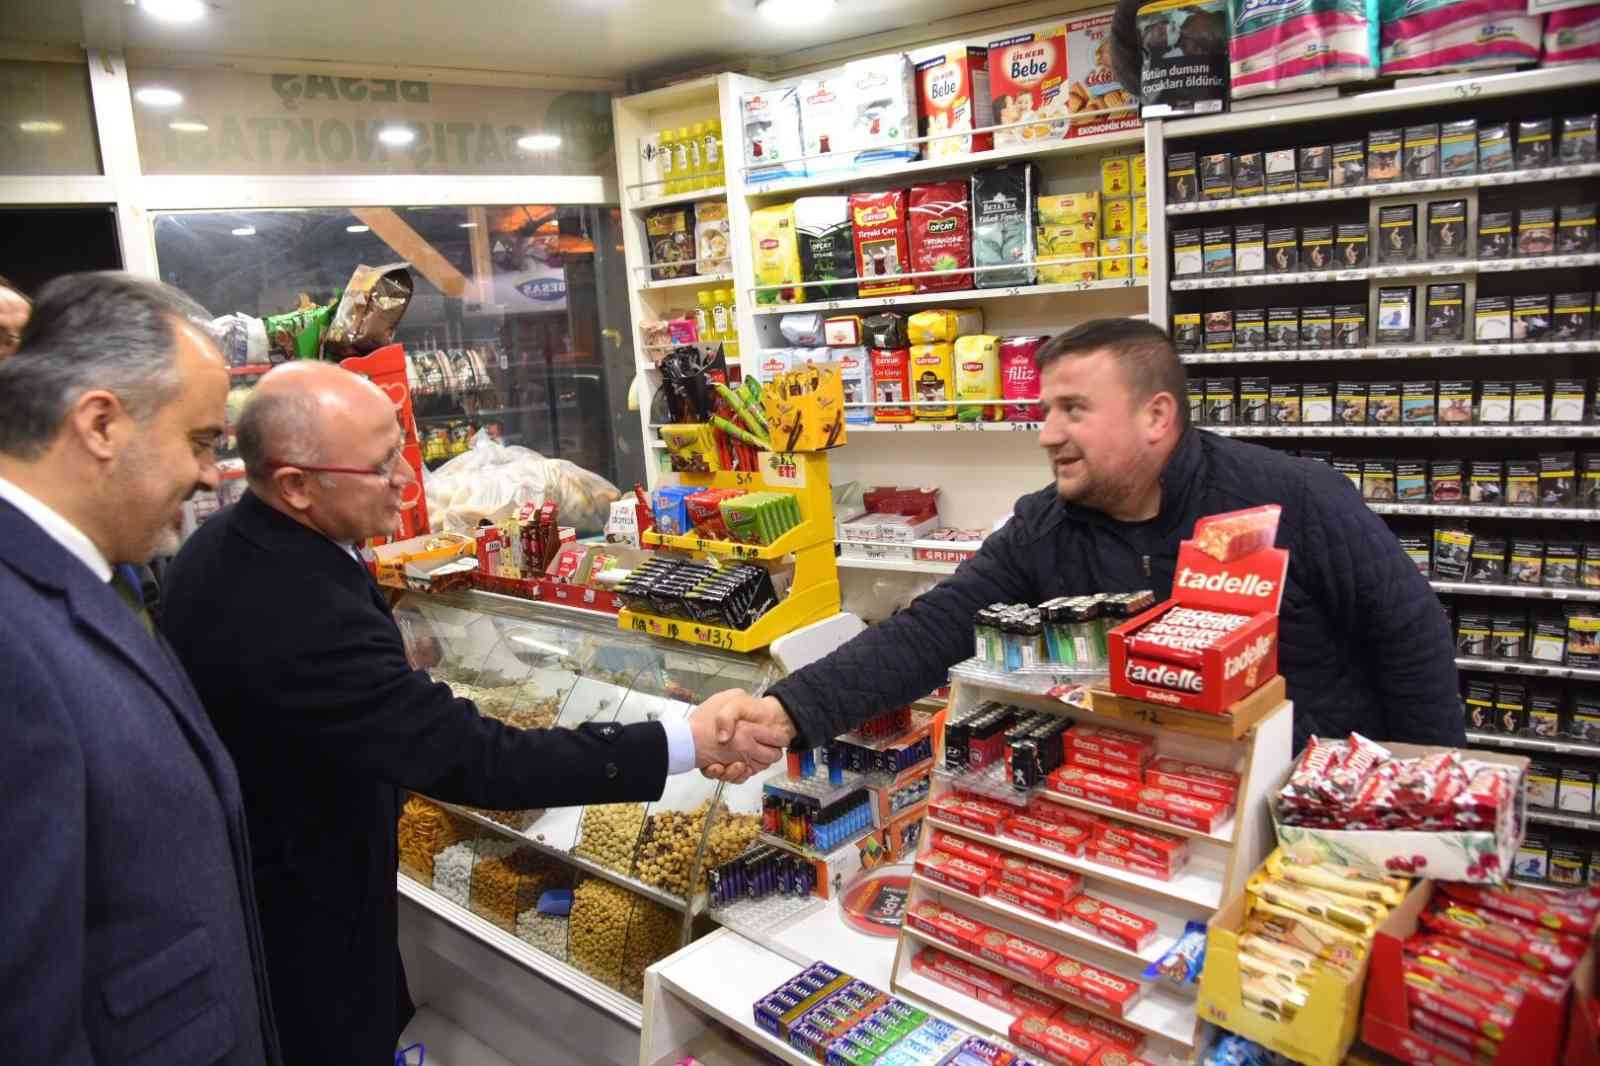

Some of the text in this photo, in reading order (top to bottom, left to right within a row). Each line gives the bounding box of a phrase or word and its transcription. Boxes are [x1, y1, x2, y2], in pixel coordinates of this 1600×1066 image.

[1011, 59, 1047, 79] Bebe
[1169, 64, 1209, 76] dumanı
[932, 80, 956, 99] Bebe
[1142, 79, 1183, 96] çocukları
[1007, 365, 1034, 384] filiz
[1178, 567, 1275, 597] tadelle
[1223, 634, 1273, 680] tadelle
[1124, 659, 1204, 692] tadelle
[1146, 690, 1181, 704] tadelle
